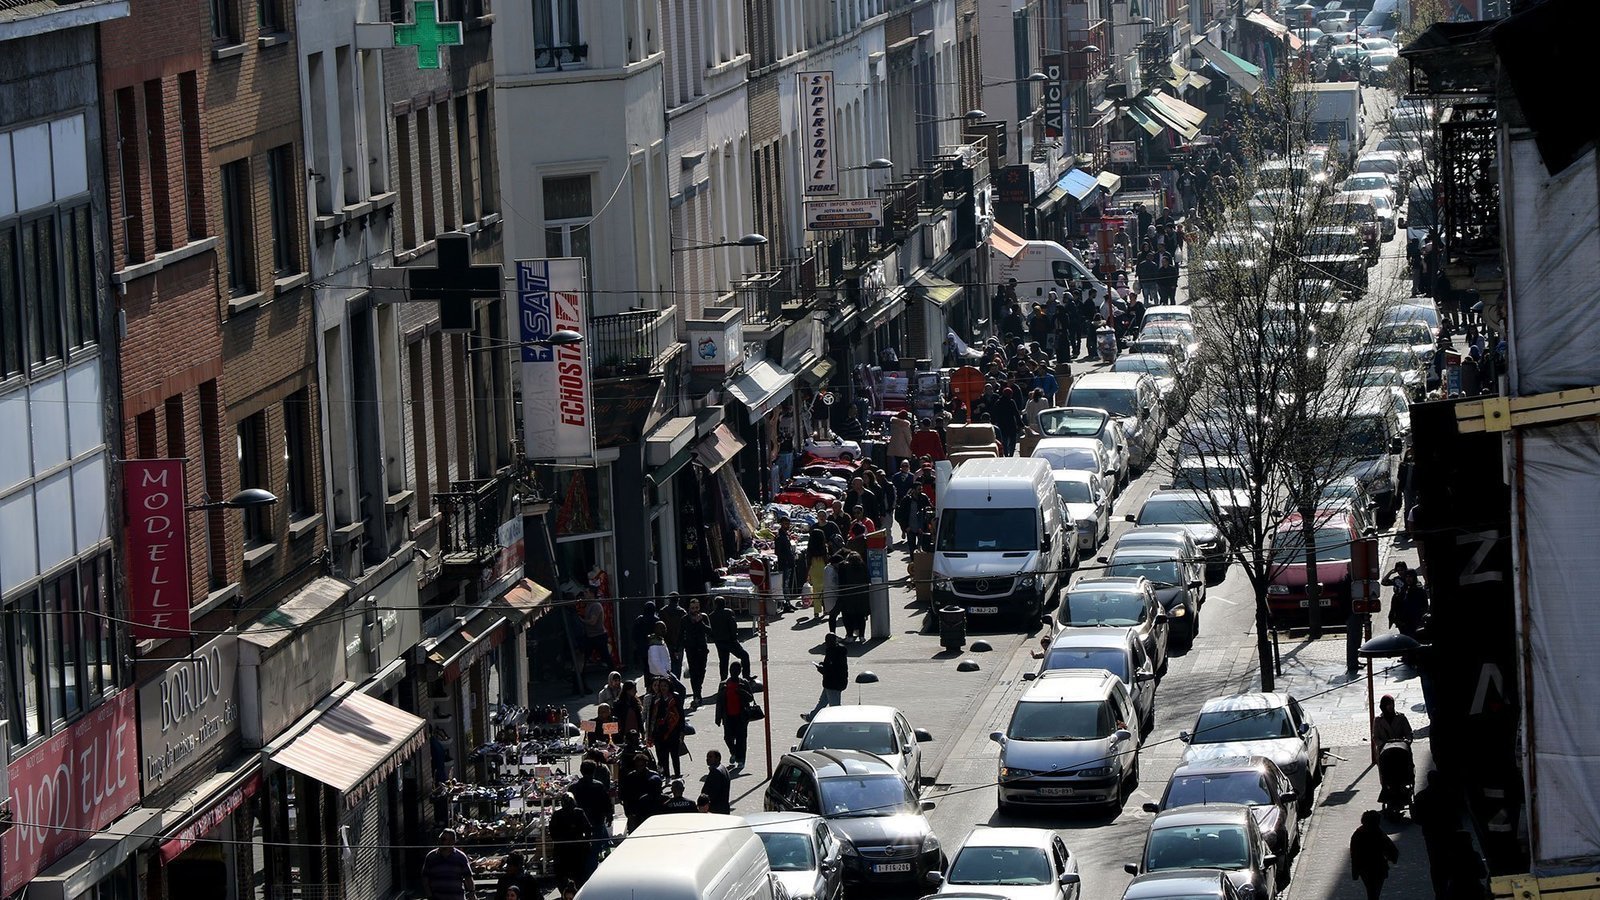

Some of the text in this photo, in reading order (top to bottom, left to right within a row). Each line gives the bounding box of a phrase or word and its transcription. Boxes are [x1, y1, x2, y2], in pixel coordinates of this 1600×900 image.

[811, 75, 828, 180] SUPERSONIC
[1047, 65, 1061, 129] Alicia
[807, 184, 835, 192] STORE
[522, 267, 550, 336] SAT
[160, 645, 222, 733] BORIDO
